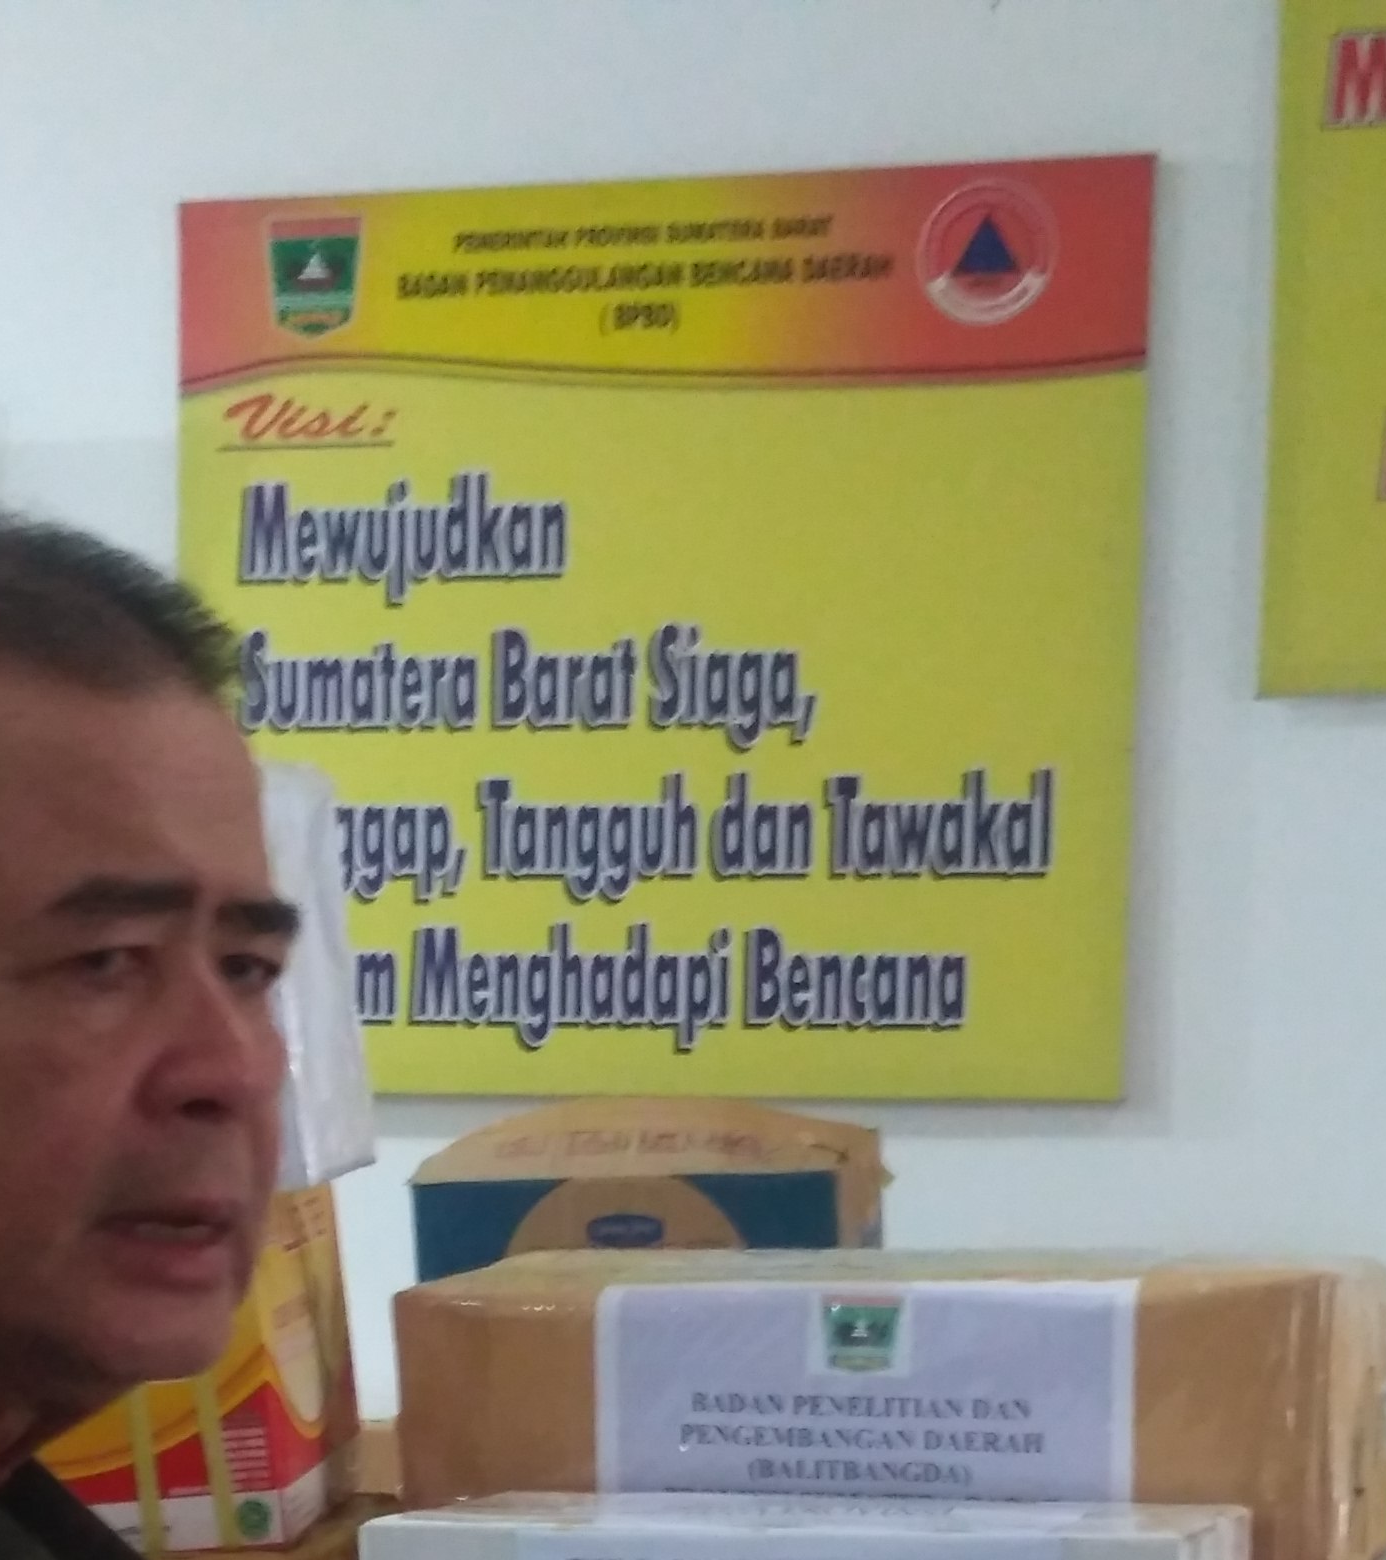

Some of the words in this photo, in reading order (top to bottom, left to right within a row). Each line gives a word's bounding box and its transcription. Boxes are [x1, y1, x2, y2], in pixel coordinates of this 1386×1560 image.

[397, 271, 468, 300] BADAN
[689, 257, 794, 287] BENCANA
[223, 392, 396, 443] Visi:
[238, 473, 566, 605] Mewujudkan
[240, 630, 477, 732] Sumatera
[493, 627, 635, 730] Barat
[651, 624, 817, 748] Siaga,
[478, 772, 698, 900] Tangguh
[712, 773, 812, 878] dan
[824, 768, 1054, 878] Tawakal
[409, 922, 733, 1050] Menghadapi
[744, 925, 967, 1029] Bencana
[691, 1392, 782, 1416] BADAN
[792, 1393, 963, 1420] PENELITIAN
[971, 1397, 1033, 1422] DAN
[679, 1424, 915, 1452] PENGEMBANGAN
[923, 1430, 1046, 1455] DAERAH
[747, 1457, 974, 1486] (BALITBANGDA)
